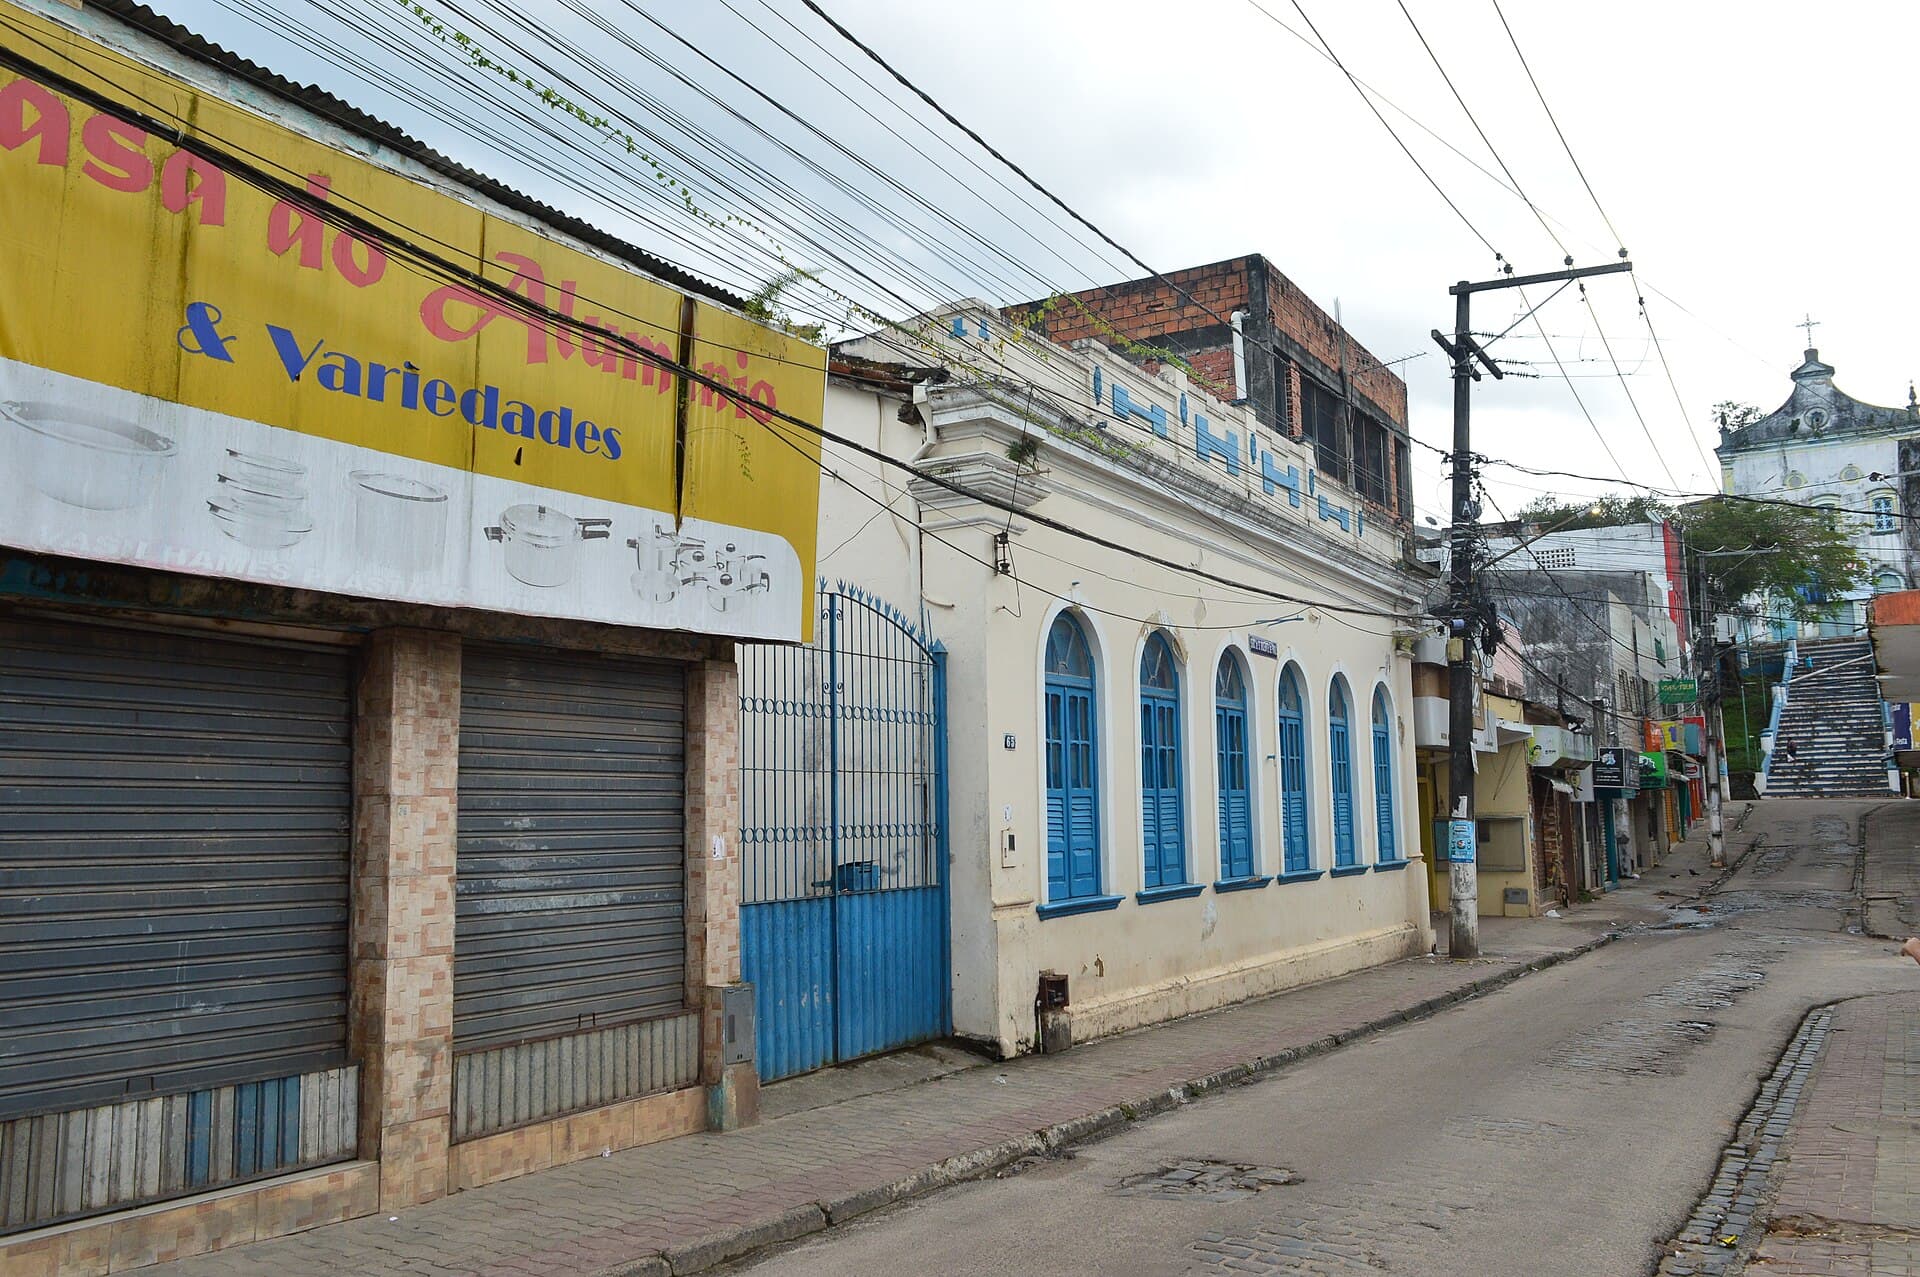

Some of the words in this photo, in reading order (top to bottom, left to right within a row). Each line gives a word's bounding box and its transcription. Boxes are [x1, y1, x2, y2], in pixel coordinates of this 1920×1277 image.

[268, 173, 388, 288] do
[420, 251, 777, 425] Alumnio
[177, 302, 237, 363] &
[266, 324, 622, 461] Variedades
[1006, 736, 1015, 748] 65
